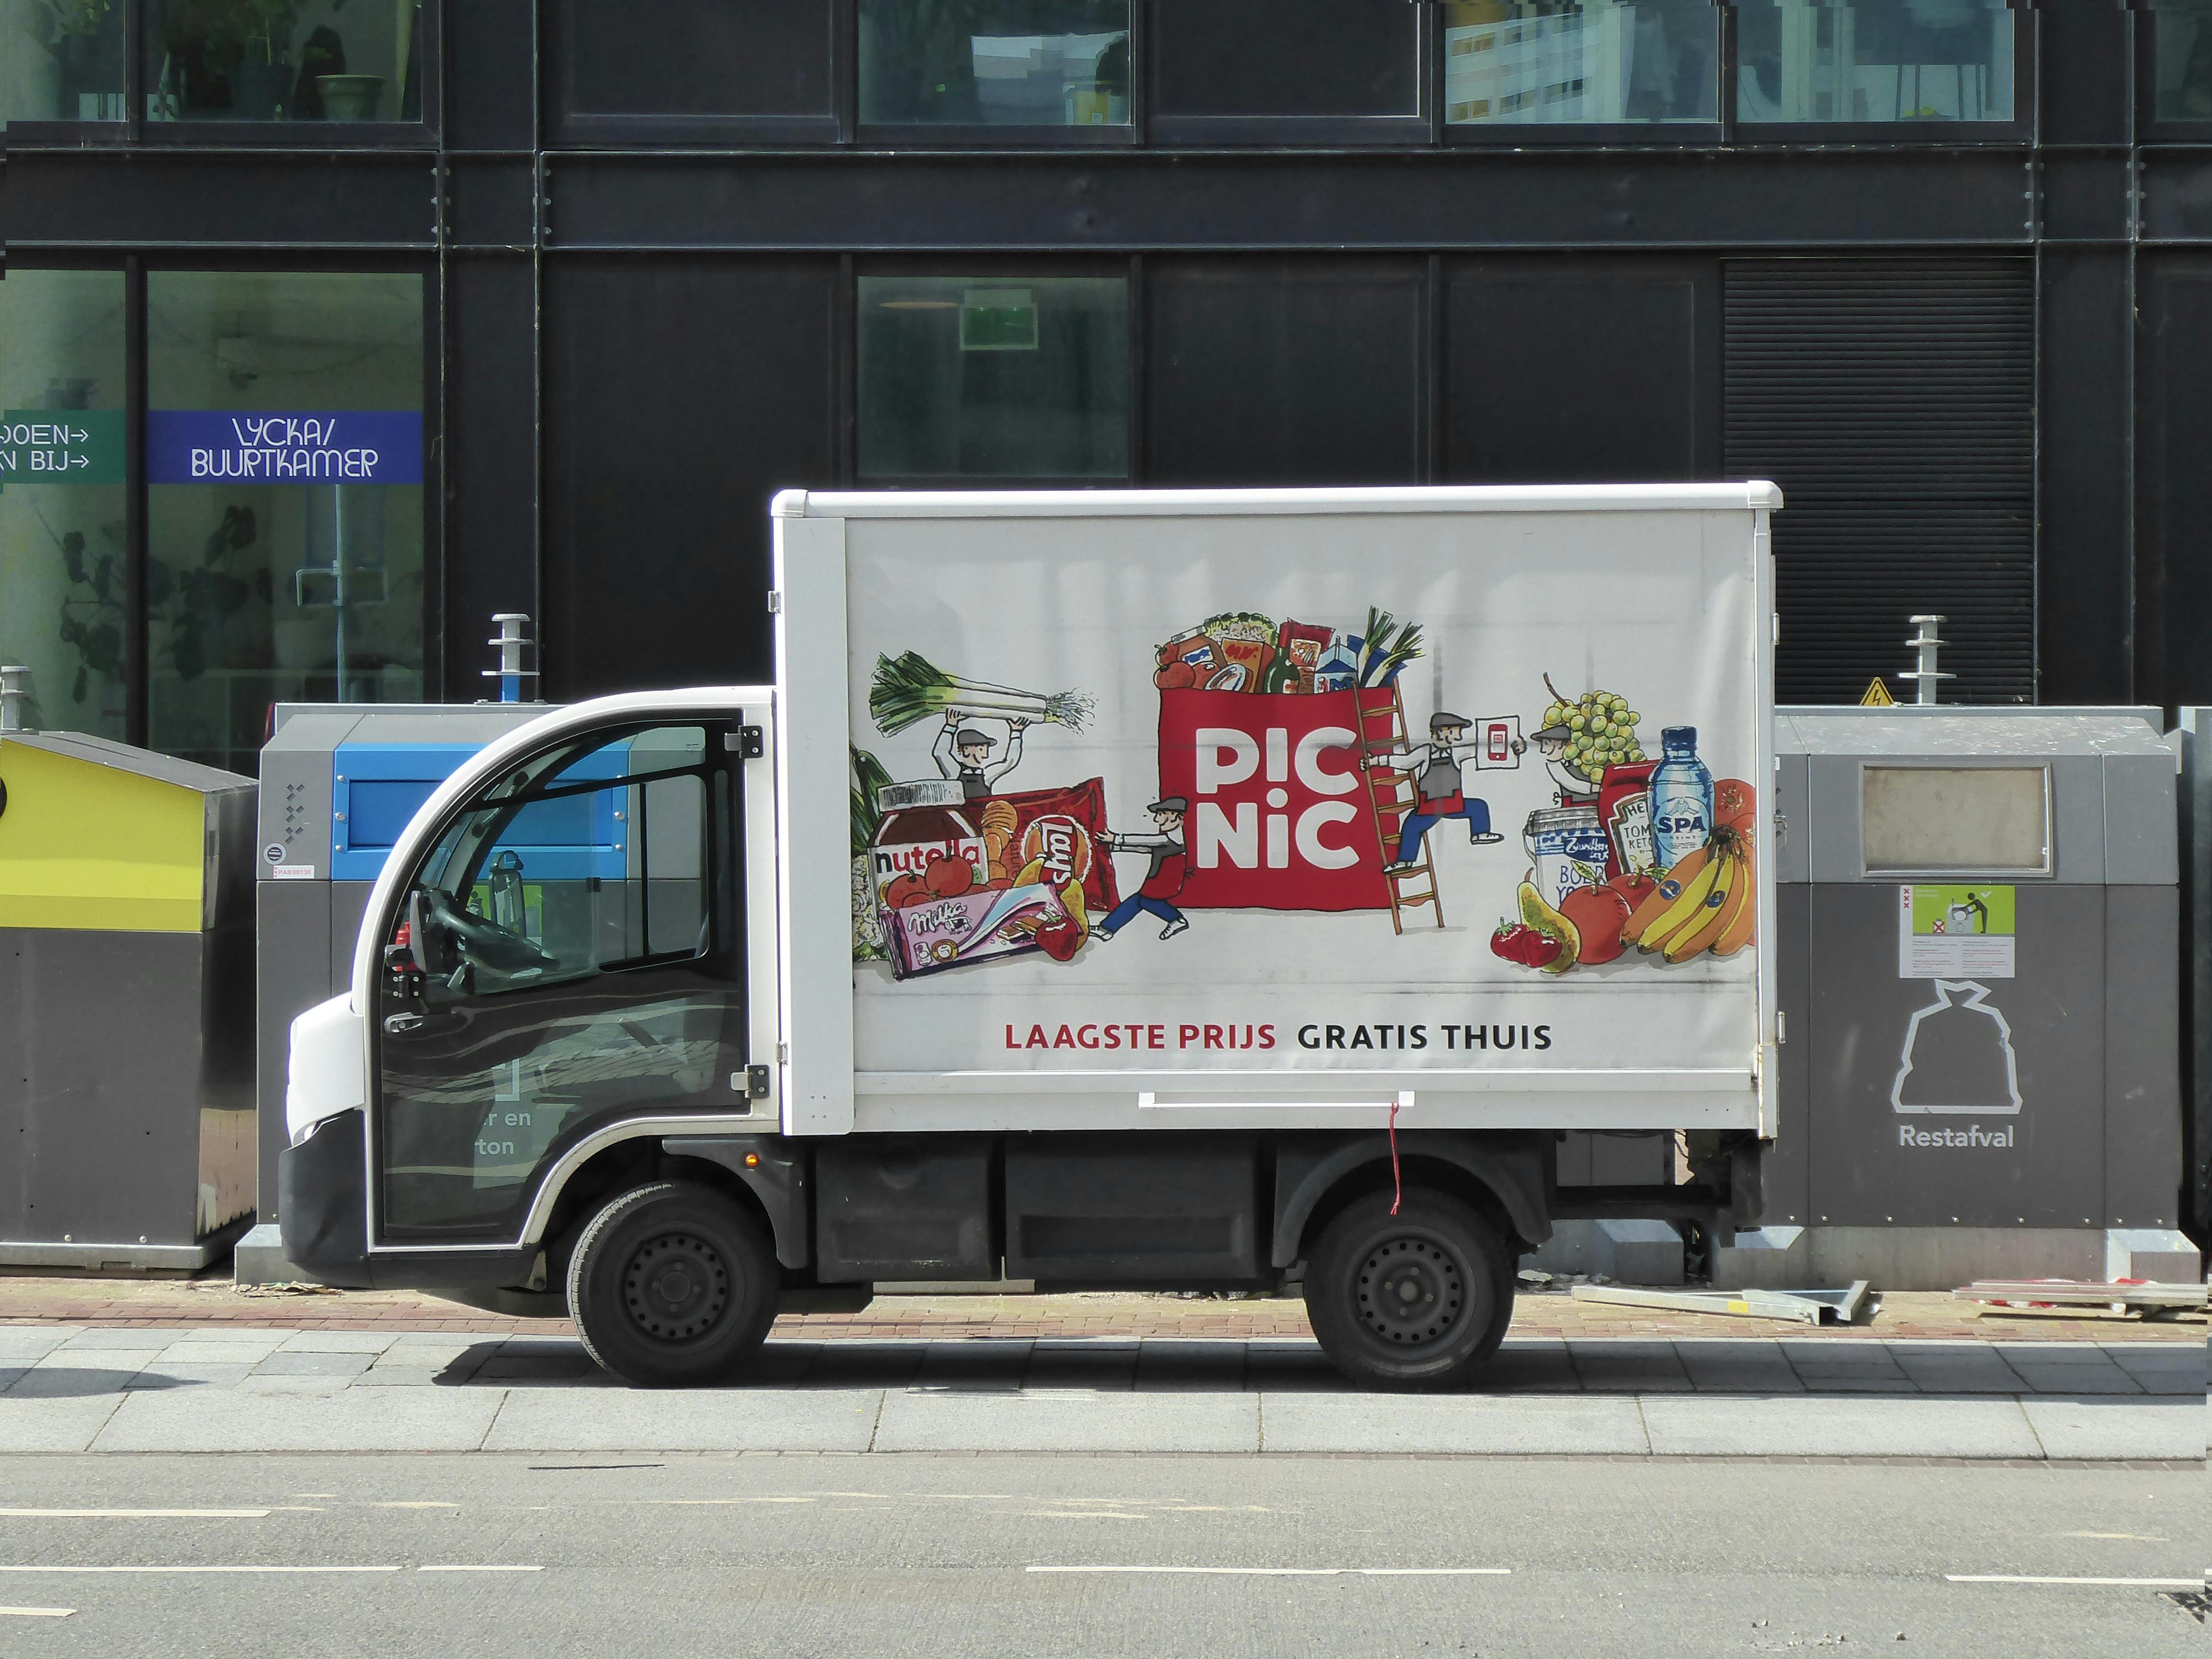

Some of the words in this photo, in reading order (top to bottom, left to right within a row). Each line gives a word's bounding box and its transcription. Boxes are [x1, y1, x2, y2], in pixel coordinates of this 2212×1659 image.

[31, 451, 68, 471] BIJ
[191, 449, 379, 477] BUURTKAMER
[1657, 816, 1707, 833] SPA
[907, 902, 967, 936] Milka
[1005, 1024, 1165, 1050] LAAGSTE
[1179, 1024, 1276, 1050] PRIJS
[1297, 1024, 1428, 1050] GRATIS
[1441, 1024, 1552, 1050] THUIS
[484, 1113, 498, 1126] r
[504, 1113, 531, 1126] en
[1899, 1124, 2014, 1147] Restafval
[474, 1139, 514, 1155] ton
